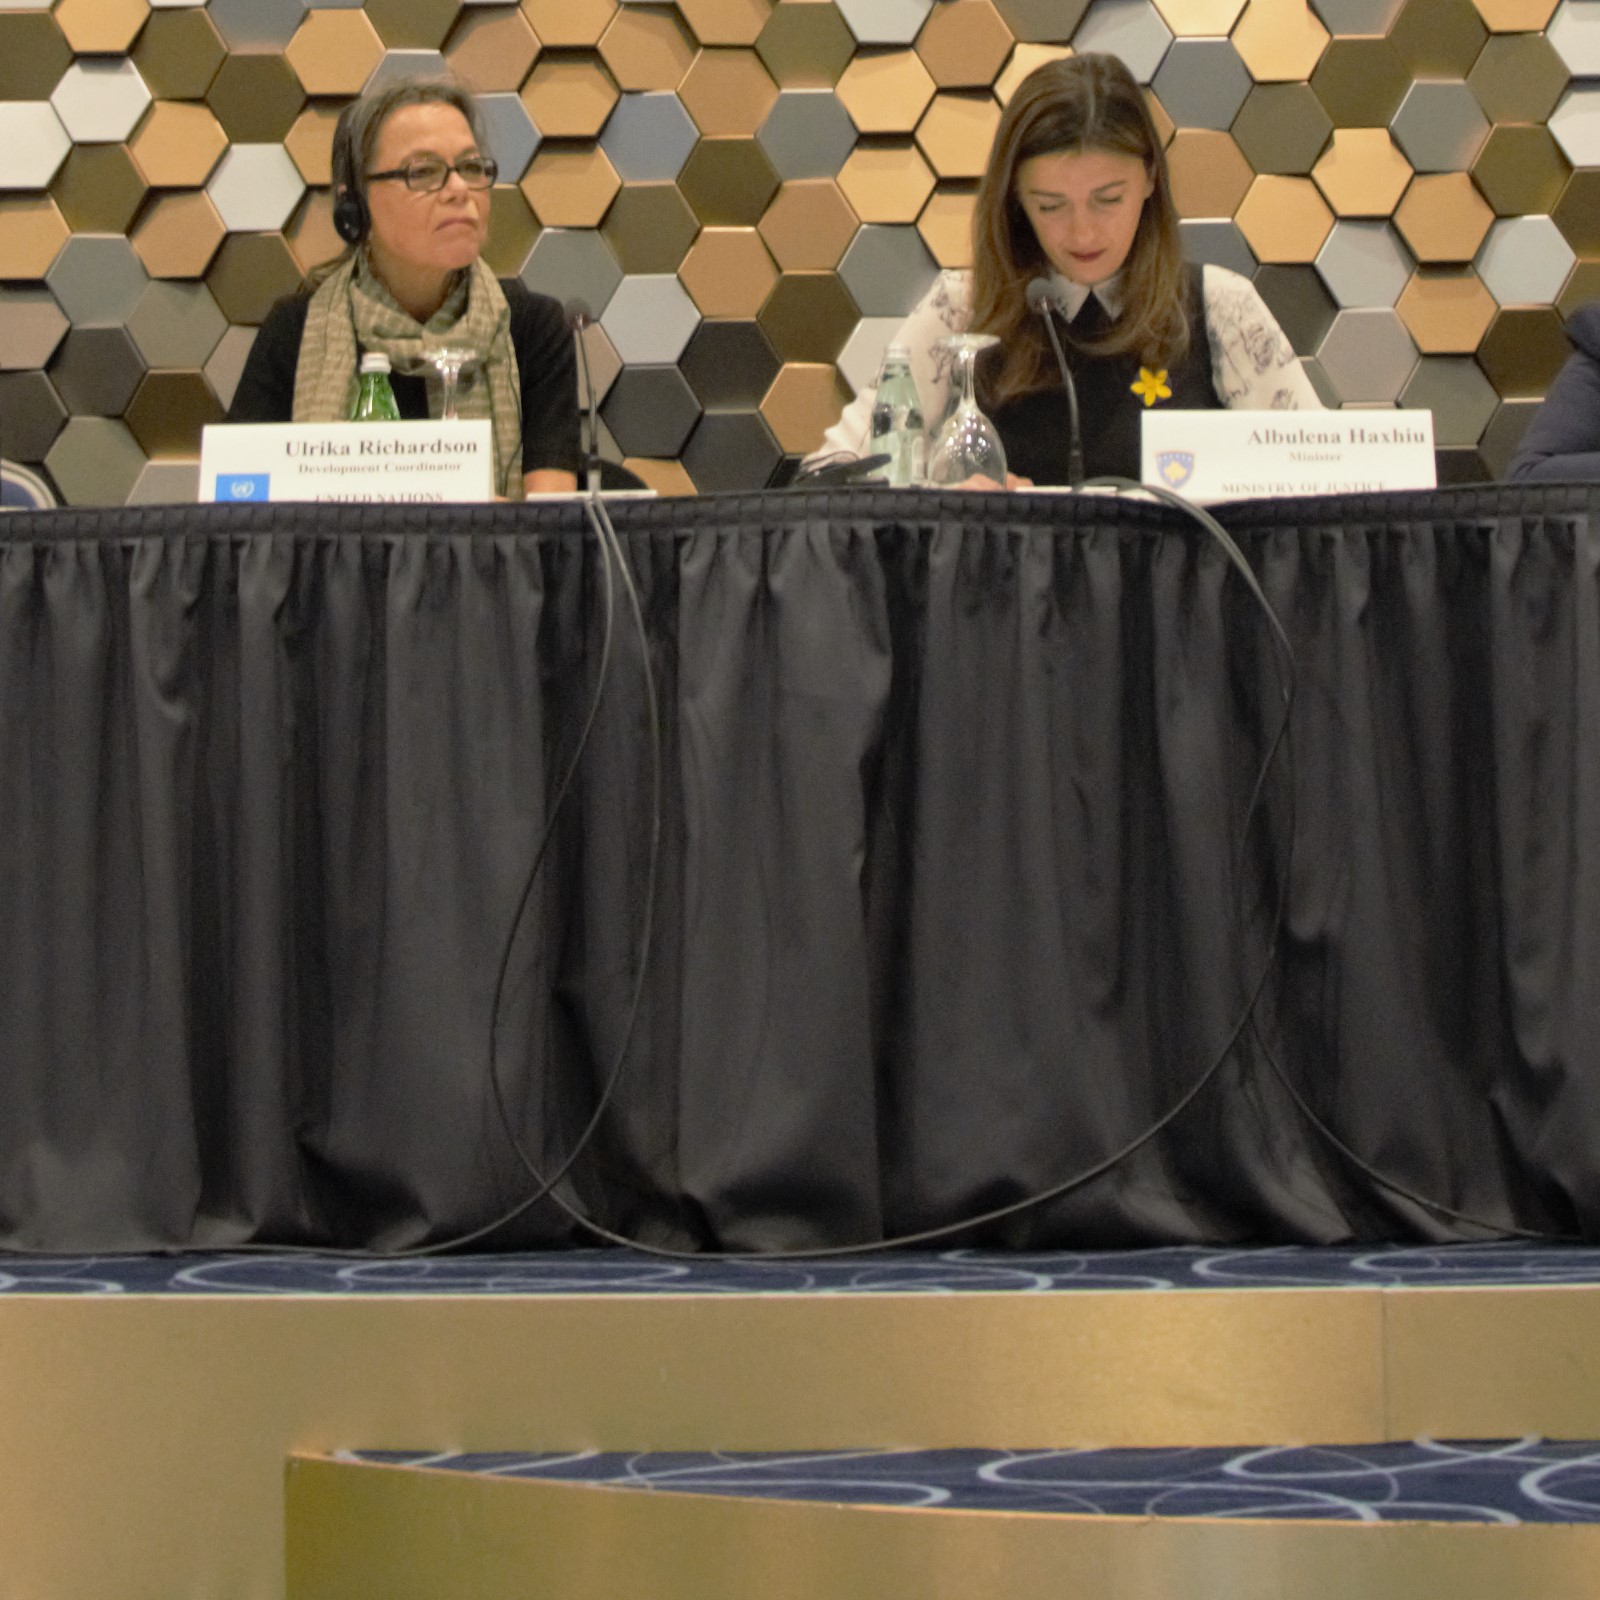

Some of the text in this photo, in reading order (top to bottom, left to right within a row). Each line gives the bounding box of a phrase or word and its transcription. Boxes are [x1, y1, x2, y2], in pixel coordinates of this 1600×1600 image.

[1248, 427, 1426, 445] Albulena Haxhiu
[285, 438, 478, 458] Ulrika Richardson
[1289, 451, 1342, 462] Minister
[299, 462, 462, 476] Development Coordinator
[1221, 482, 1298, 494] MINISTRY
